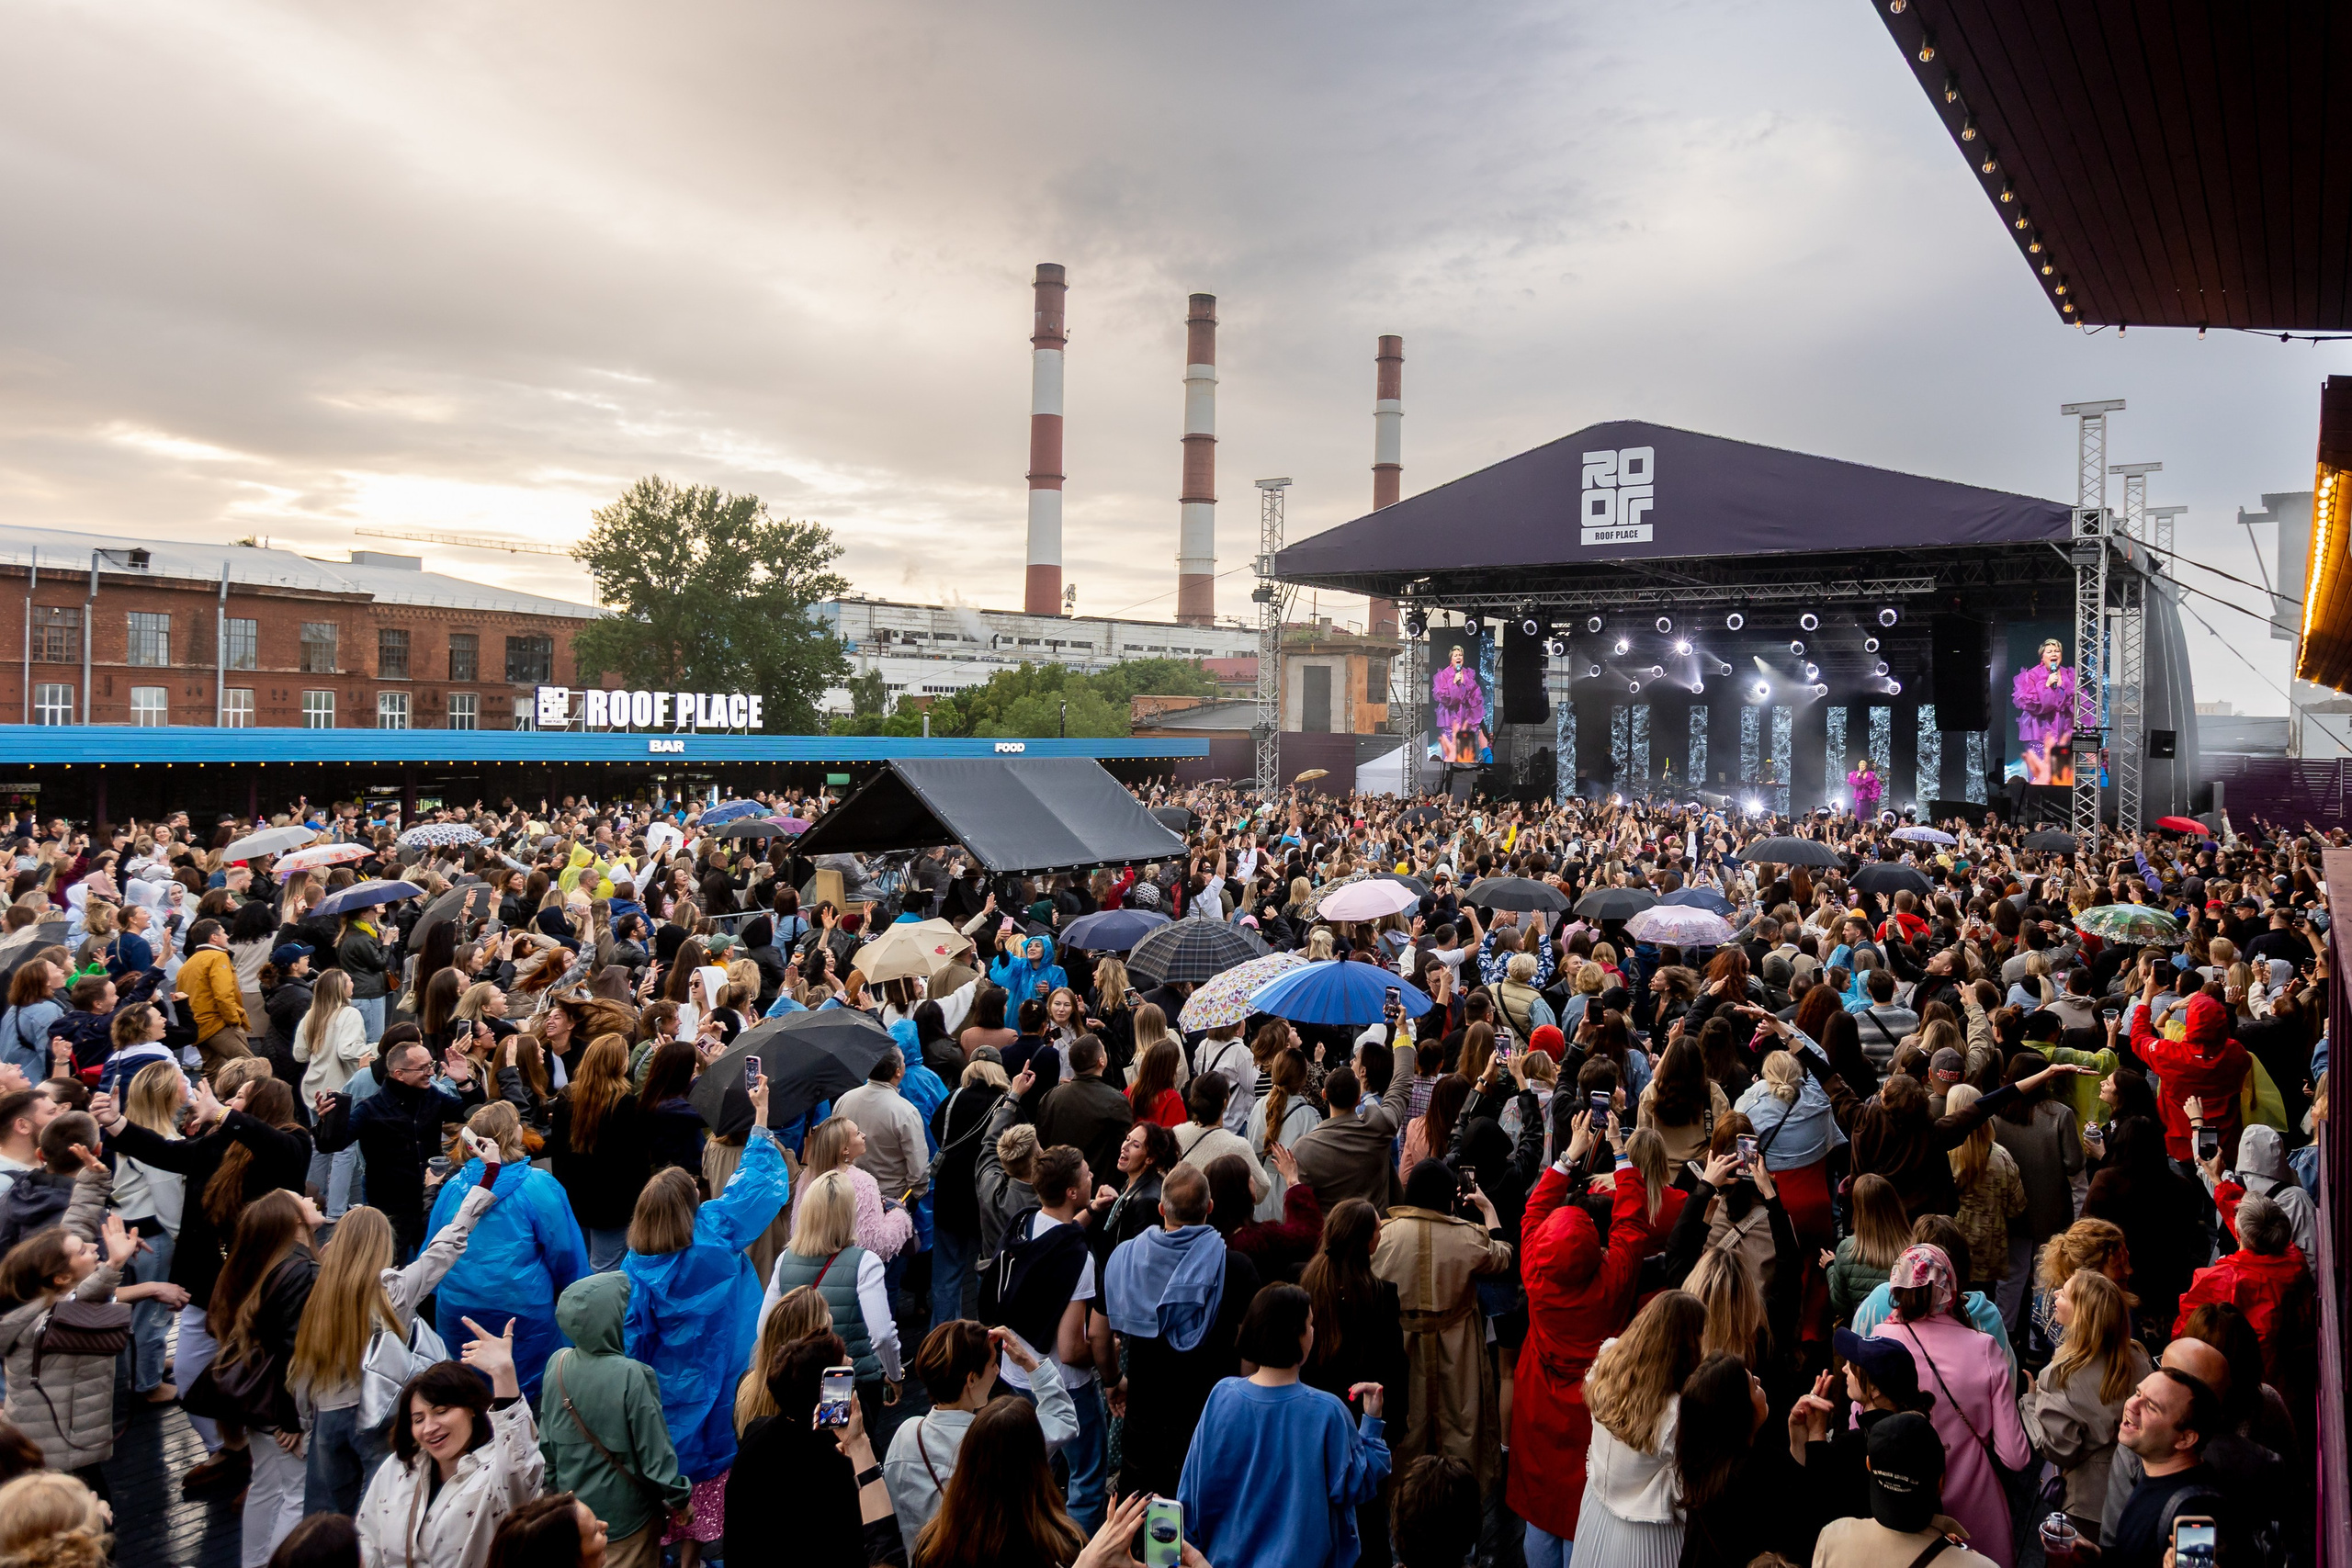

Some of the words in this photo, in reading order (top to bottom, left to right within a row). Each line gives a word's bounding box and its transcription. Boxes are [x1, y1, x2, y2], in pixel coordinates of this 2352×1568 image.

[1595, 531, 1614, 540] ROOF
[1615, 529, 1638, 539] PLACE
[585, 689, 670, 728] ROOF
[675, 692, 763, 728] PLACE
[649, 739, 684, 752] BAR
[994, 742, 1025, 752] FOOD
